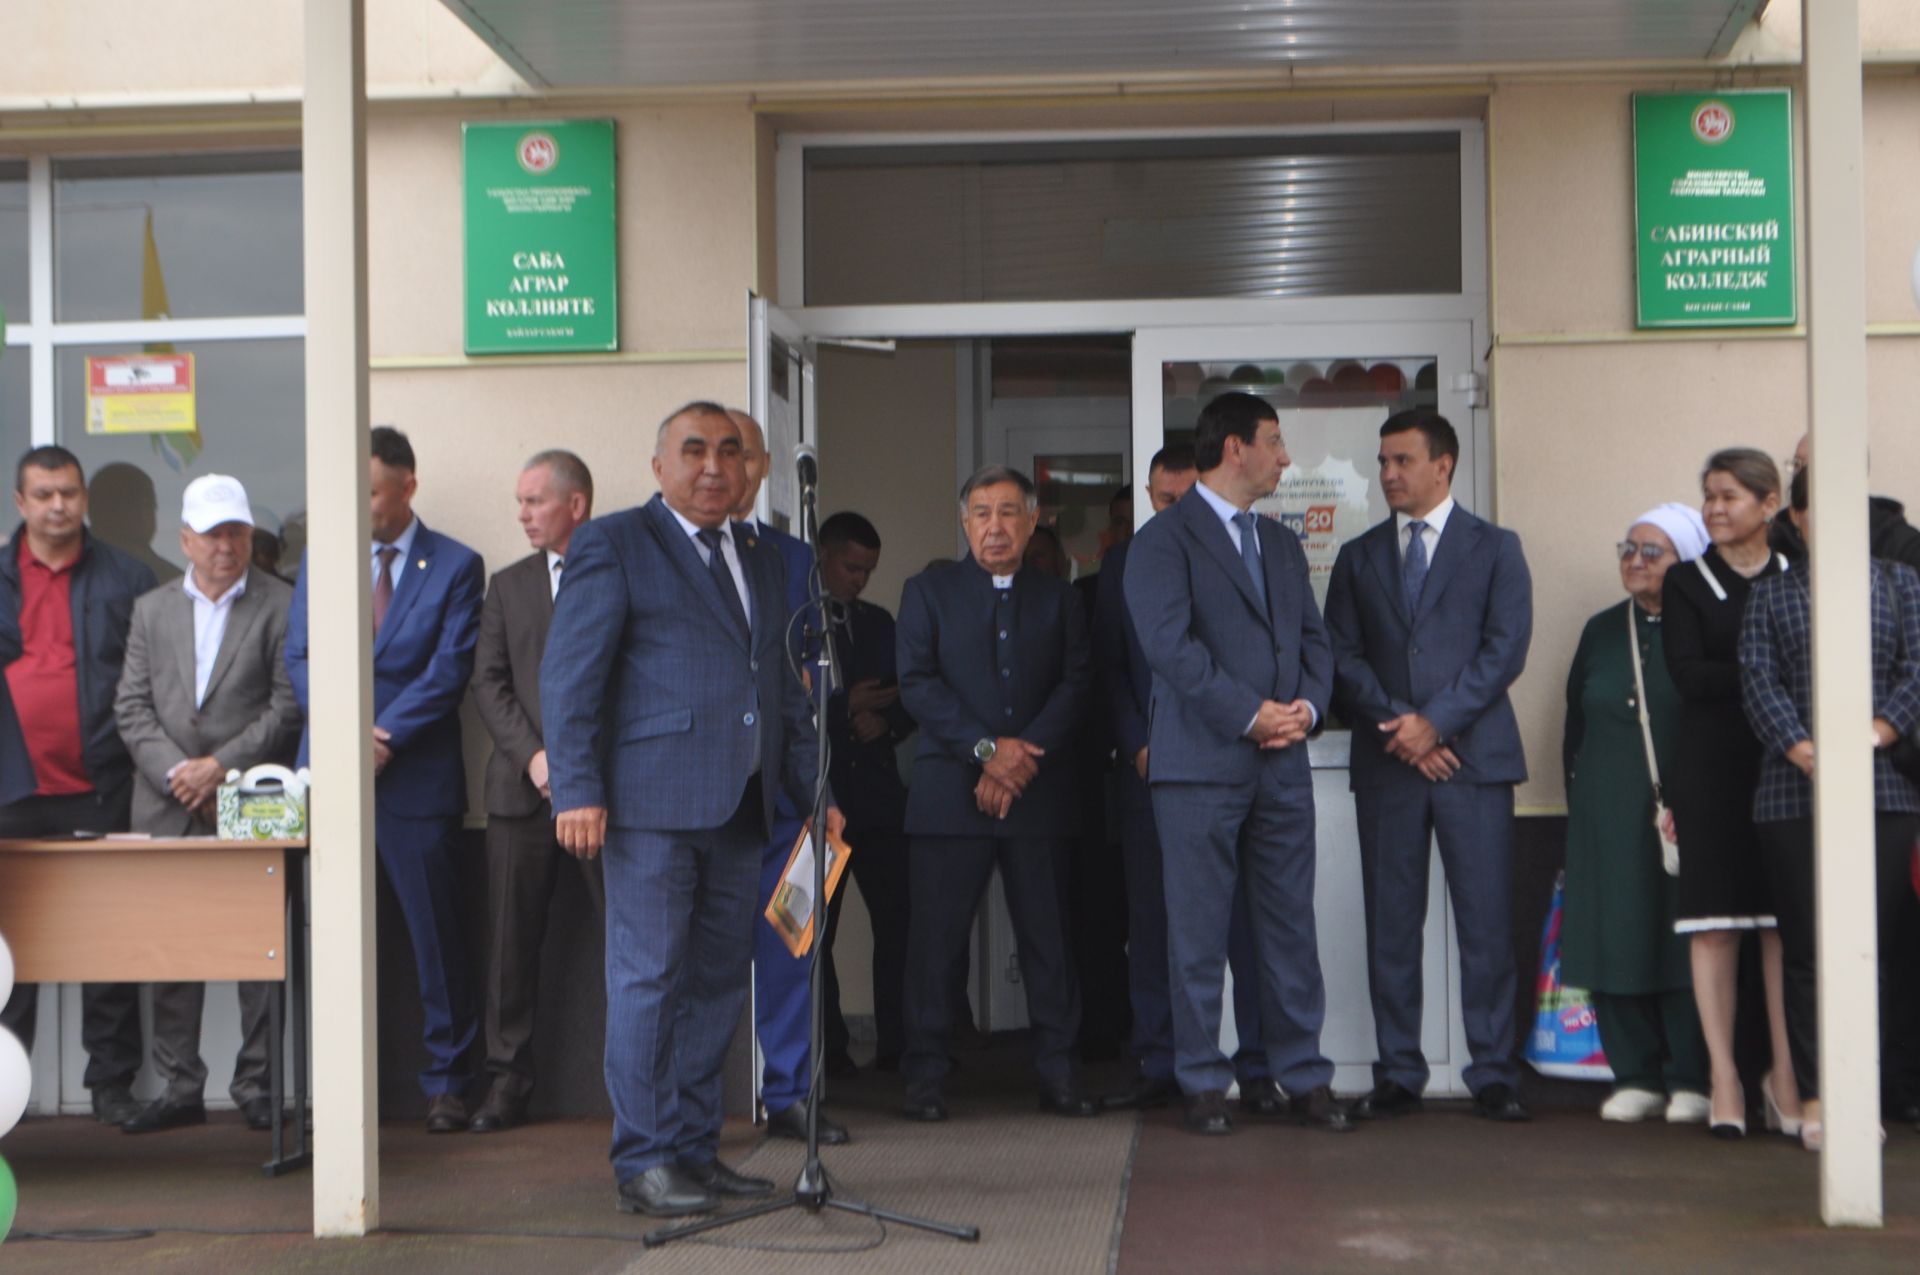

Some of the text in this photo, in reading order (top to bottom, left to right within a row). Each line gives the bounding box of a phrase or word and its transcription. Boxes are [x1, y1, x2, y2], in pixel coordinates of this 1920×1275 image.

[1650, 218, 1779, 243] САБИНСКИЙ
[512, 250, 566, 271] САБА
[1660, 243, 1771, 267] АГРАРНЫЙ
[508, 274, 570, 293] АГРАР
[1665, 270, 1768, 291] КОЛЛЕДЖ
[1306, 510, 1332, 530] 20
